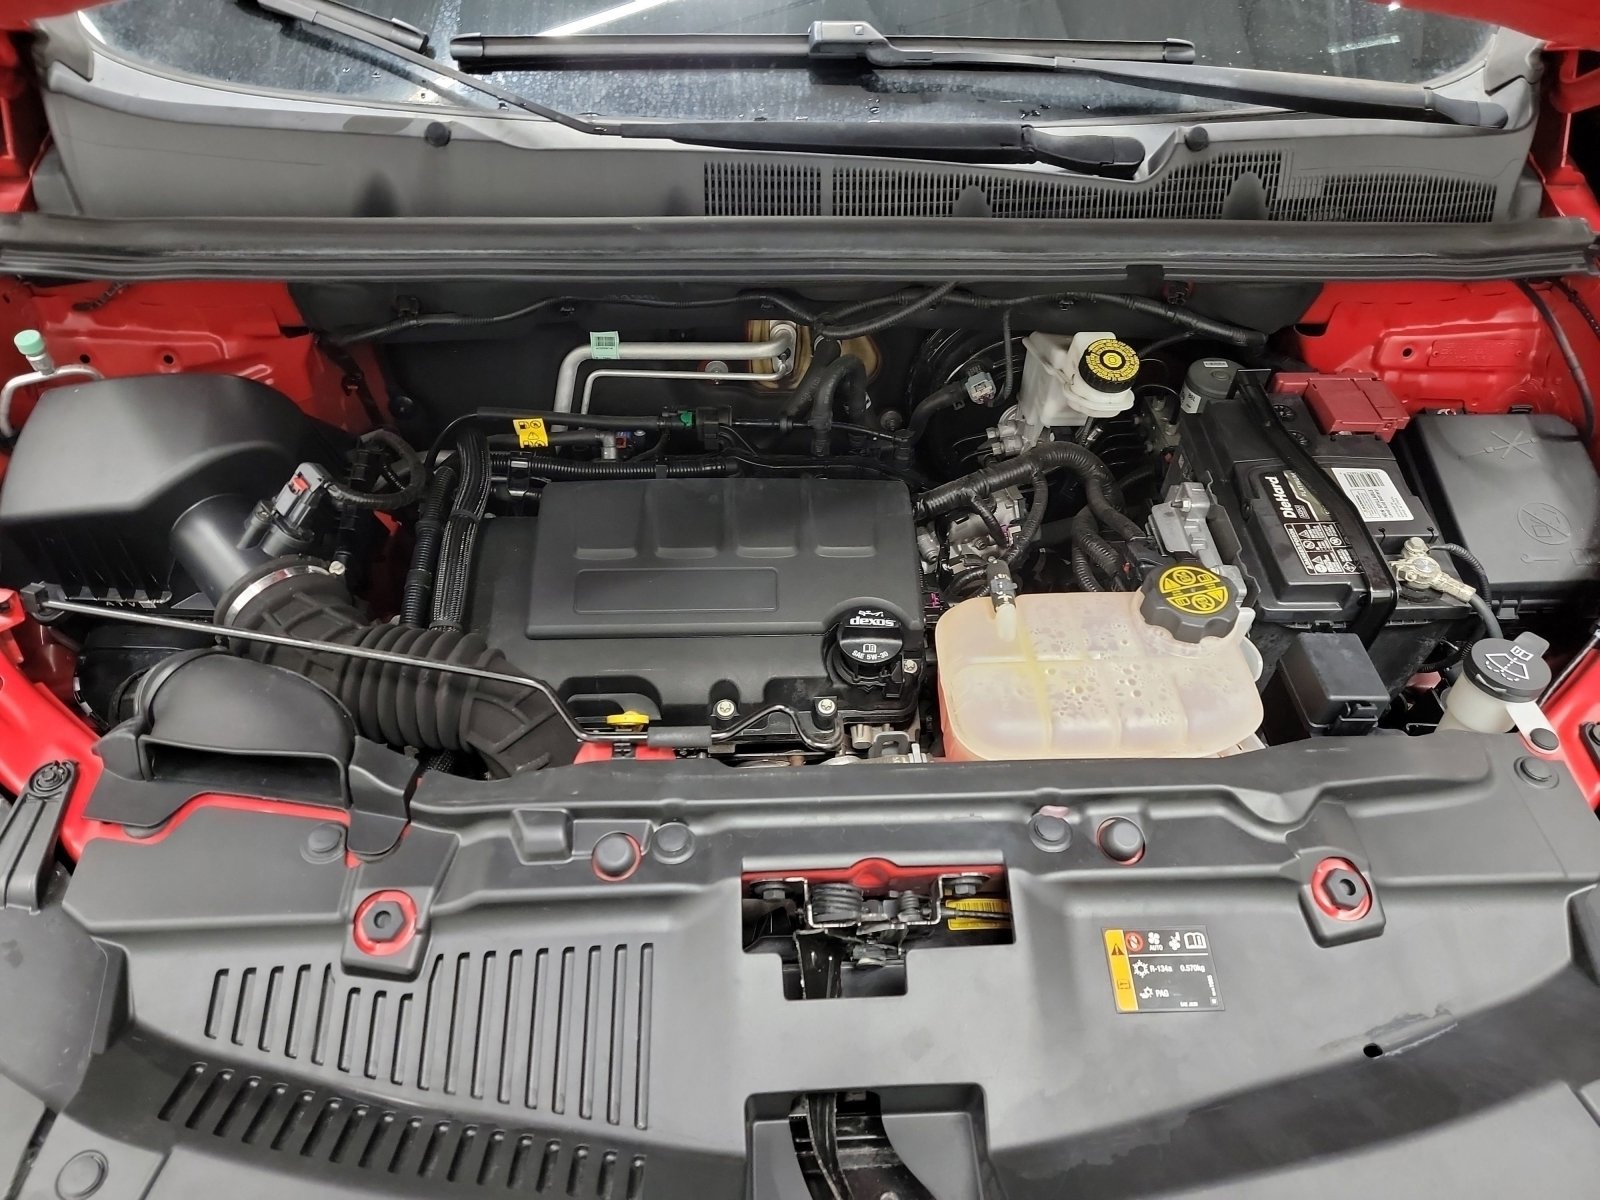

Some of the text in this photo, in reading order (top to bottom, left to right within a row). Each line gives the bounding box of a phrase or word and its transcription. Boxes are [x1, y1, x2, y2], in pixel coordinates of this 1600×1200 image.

[1264, 476, 1297, 518] DieHard
[849, 616, 895, 627] dexos
[851, 649, 889, 660] SAE 5W-30
[1150, 964, 1206, 973] R-134a 0.570kg
[1155, 989, 1169, 998] PAG
